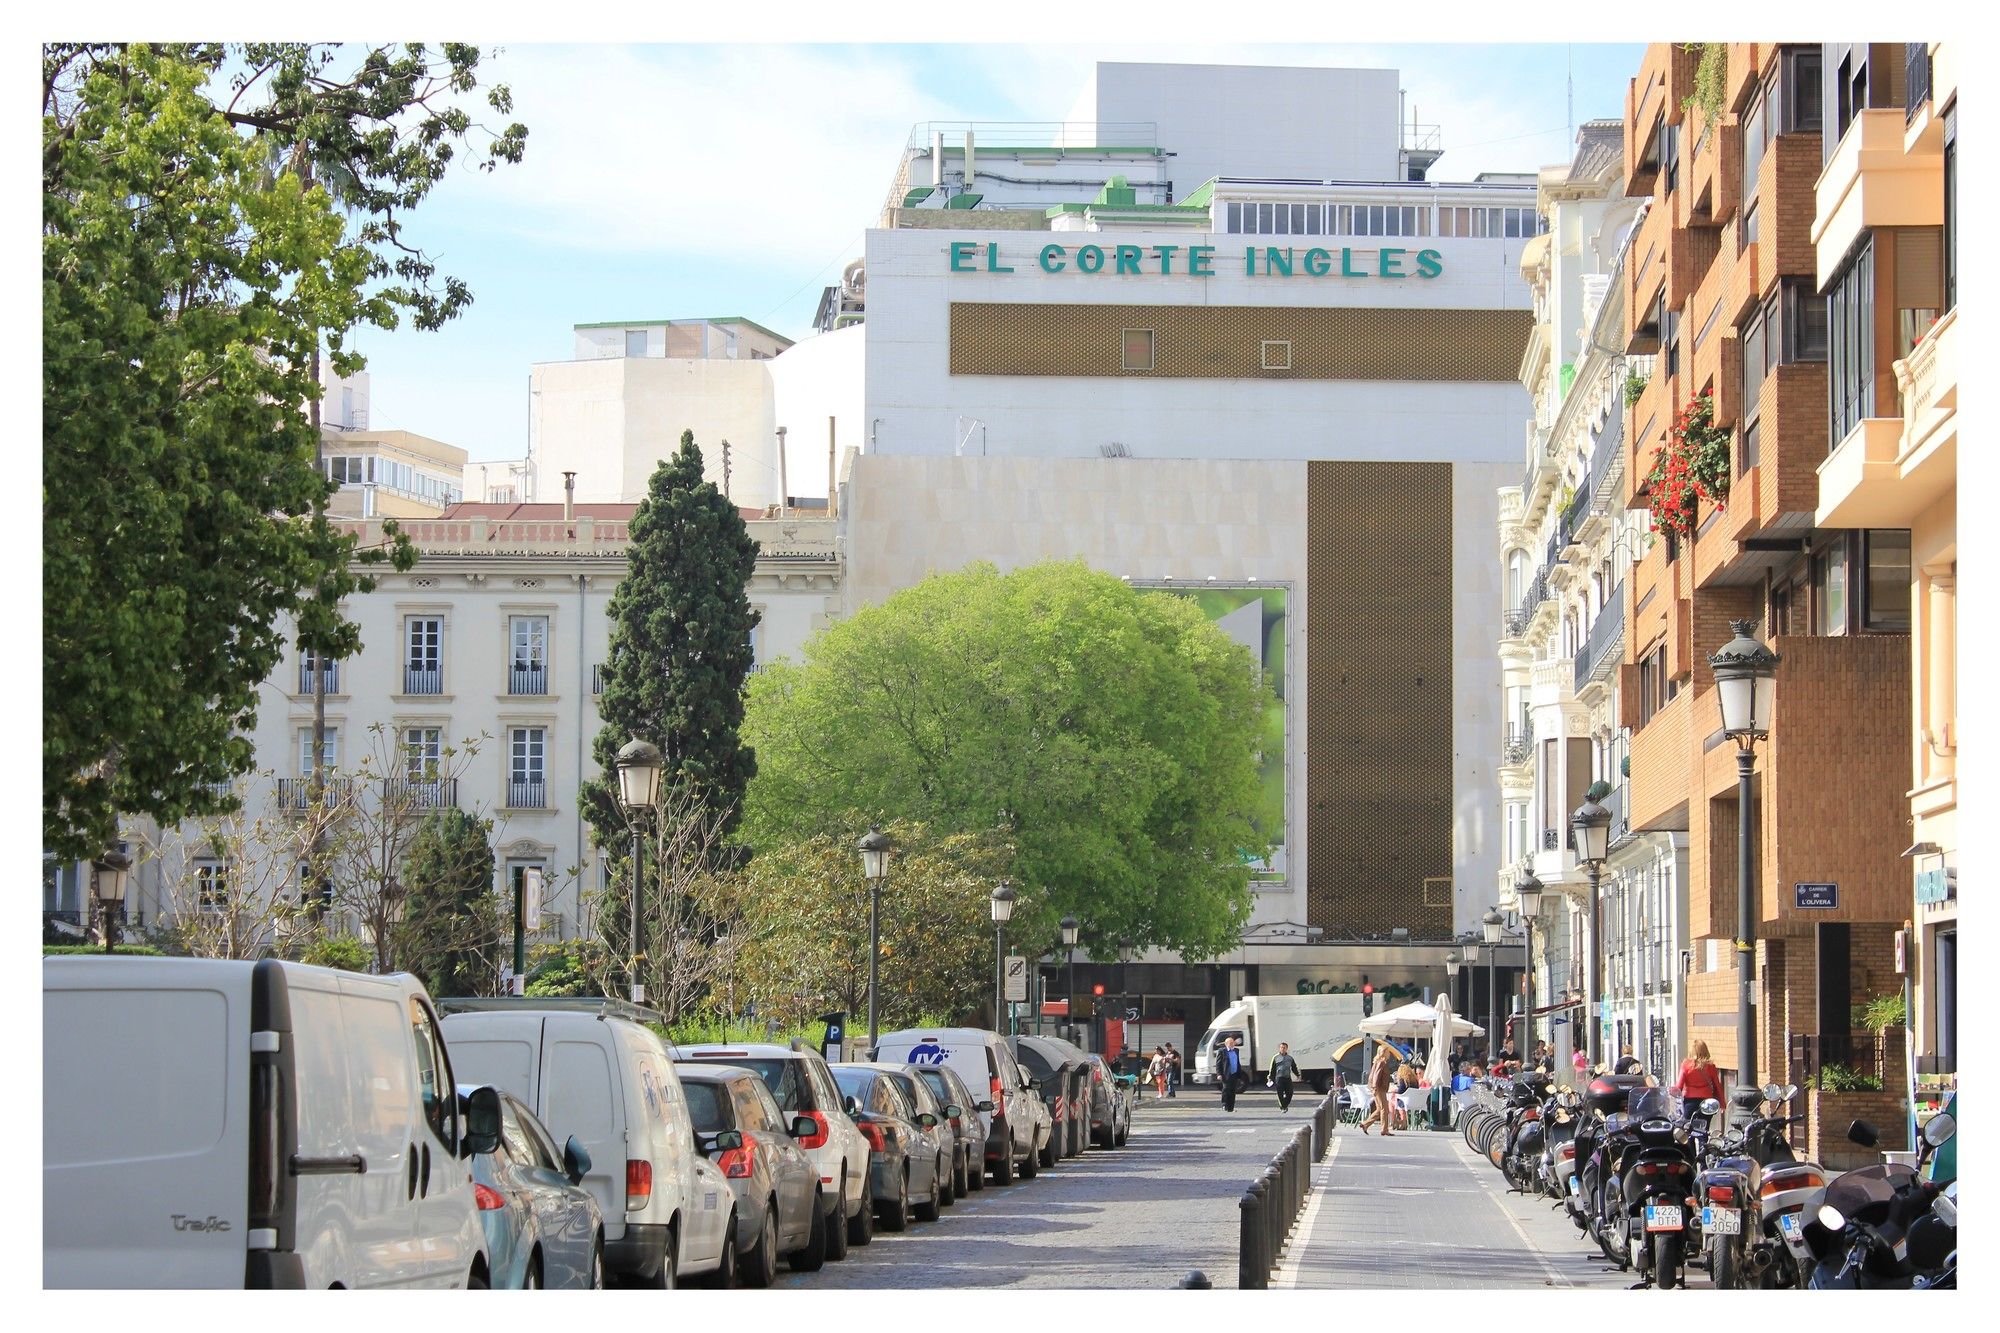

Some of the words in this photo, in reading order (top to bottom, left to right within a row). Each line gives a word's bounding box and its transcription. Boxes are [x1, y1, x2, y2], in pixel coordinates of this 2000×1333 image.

[950, 241, 1014, 273] EL
[1039, 243, 1215, 276] CORTE
[1246, 246, 1444, 279] INGLES
[830, 1025, 840, 1039] P
[1655, 1206, 1681, 1216] 4220
[170, 1214, 232, 1233] Trafic
[1658, 1216, 1678, 1226] DTR
[1711, 1221, 1740, 1233] 3050
